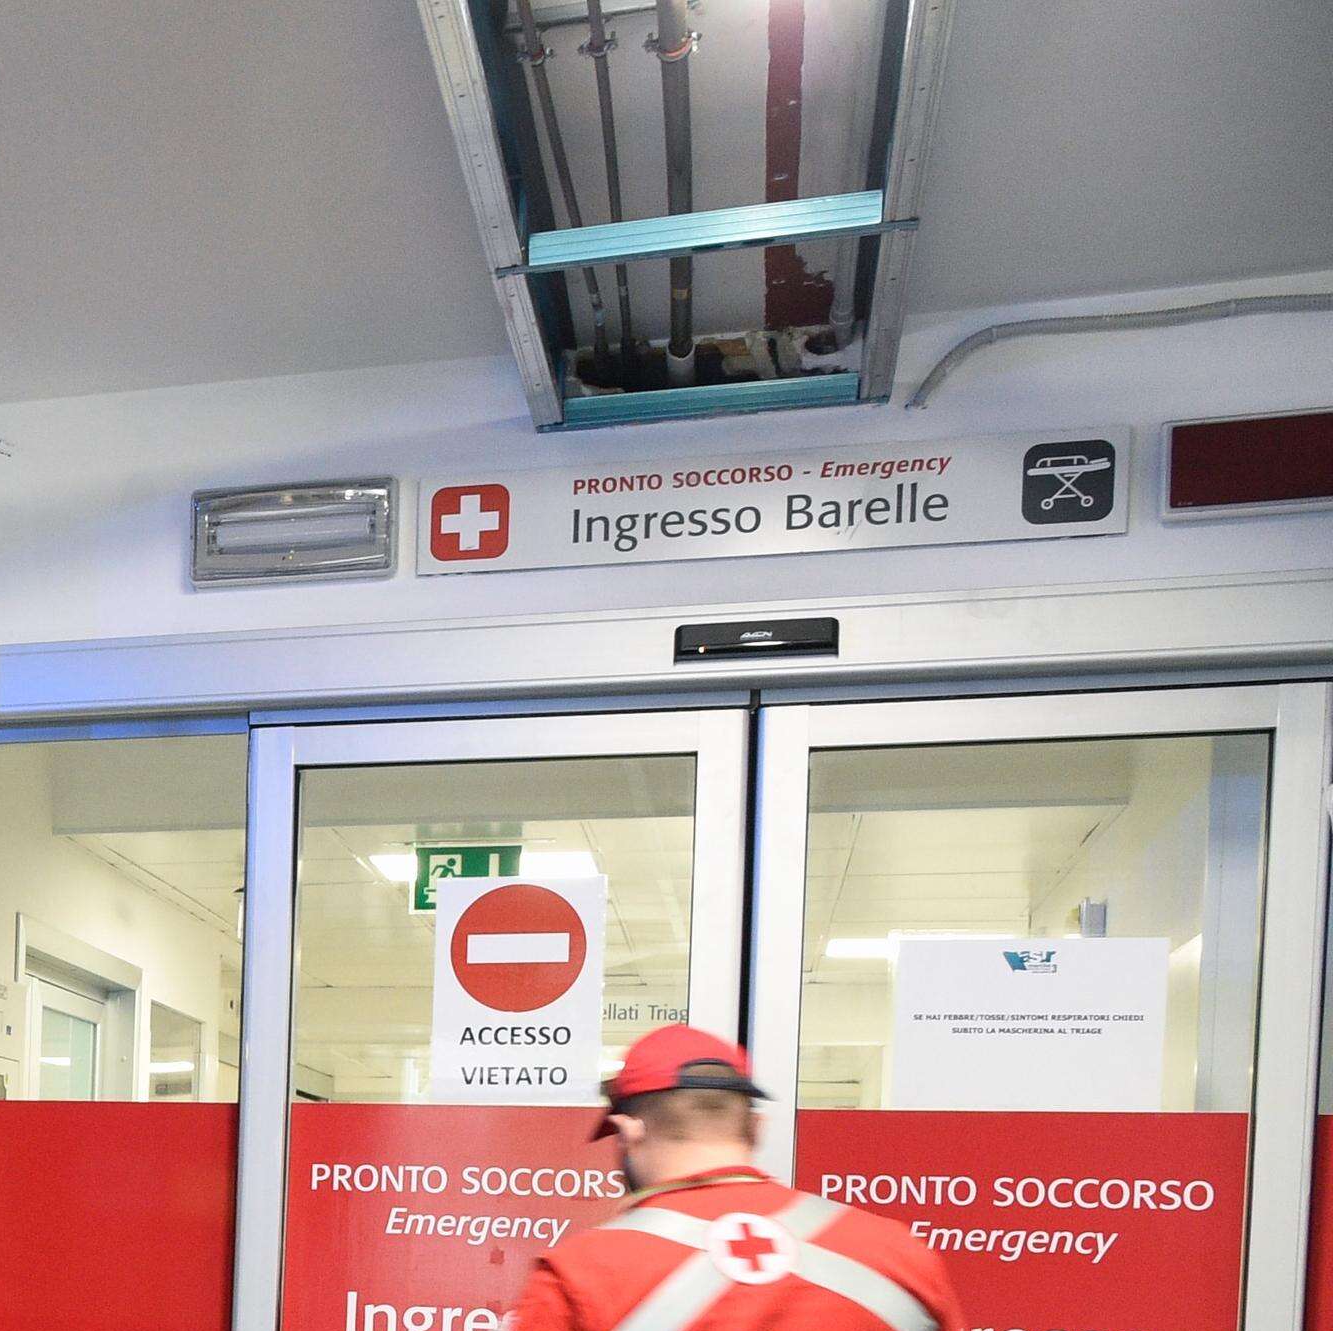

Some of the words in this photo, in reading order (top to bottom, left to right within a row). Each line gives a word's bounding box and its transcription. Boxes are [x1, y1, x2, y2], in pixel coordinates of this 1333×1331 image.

[572, 473, 664, 496] PRONTO
[671, 464, 794, 489] SOCCORSO
[819, 455, 953, 481] Emergency
[571, 504, 762, 553] Ingresso
[785, 482, 950, 531] Barelle
[998, 1027, 1055, 1035] MASCHERINA
[1057, 1027, 1068, 1035] AL
[1070, 1027, 1103, 1036] TRIAGE
[1050, 1014, 1110, 1022] RESPIRATORI
[1112, 1014, 1145, 1022] CHIEDI
[459, 1025, 572, 1047] ACCESSO
[461, 1065, 569, 1087] VIETATO
[309, 1162, 448, 1195] PRONTO
[819, 1173, 977, 1207] PRONTO
[992, 1176, 1215, 1212] SOCCORSO
[384, 1206, 571, 1248] Emergency
